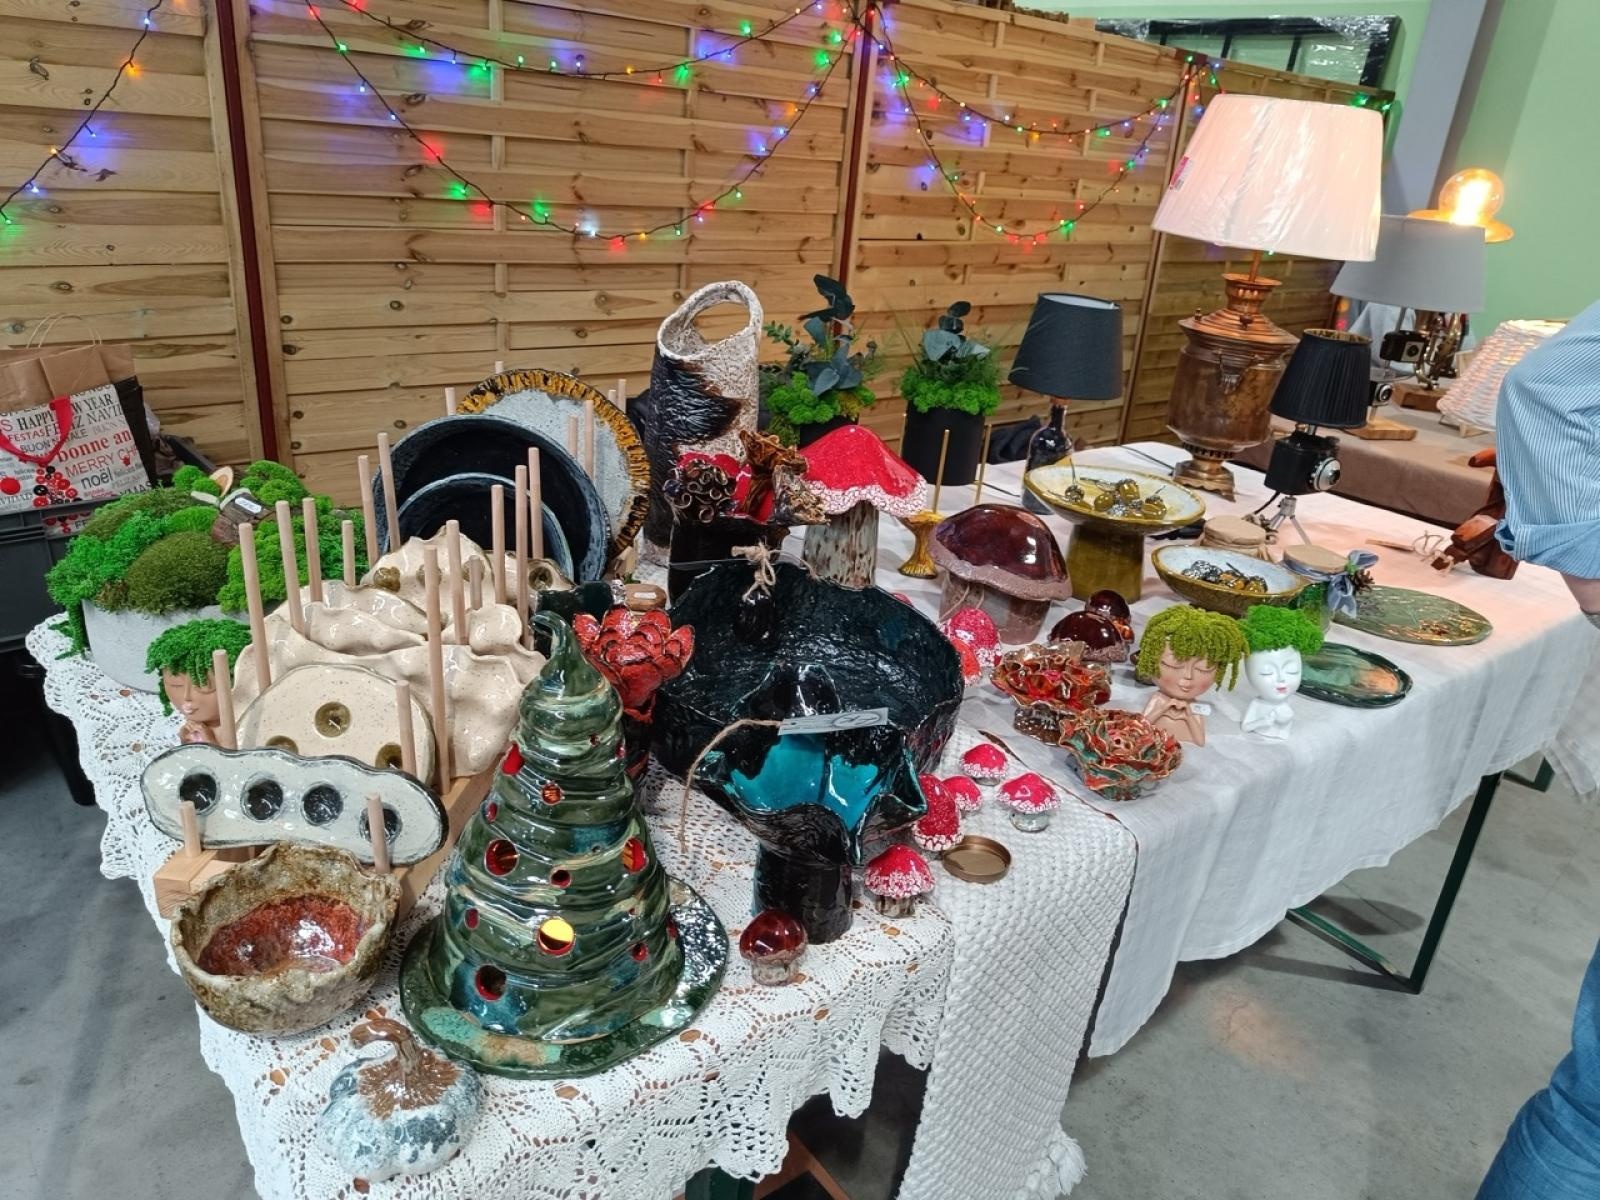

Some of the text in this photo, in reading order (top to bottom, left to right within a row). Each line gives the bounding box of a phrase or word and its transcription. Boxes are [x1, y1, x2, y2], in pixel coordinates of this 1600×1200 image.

[83, 394, 113, 410] YEAR
[65, 453, 114, 478] MERRY
[81, 467, 113, 489] noël
